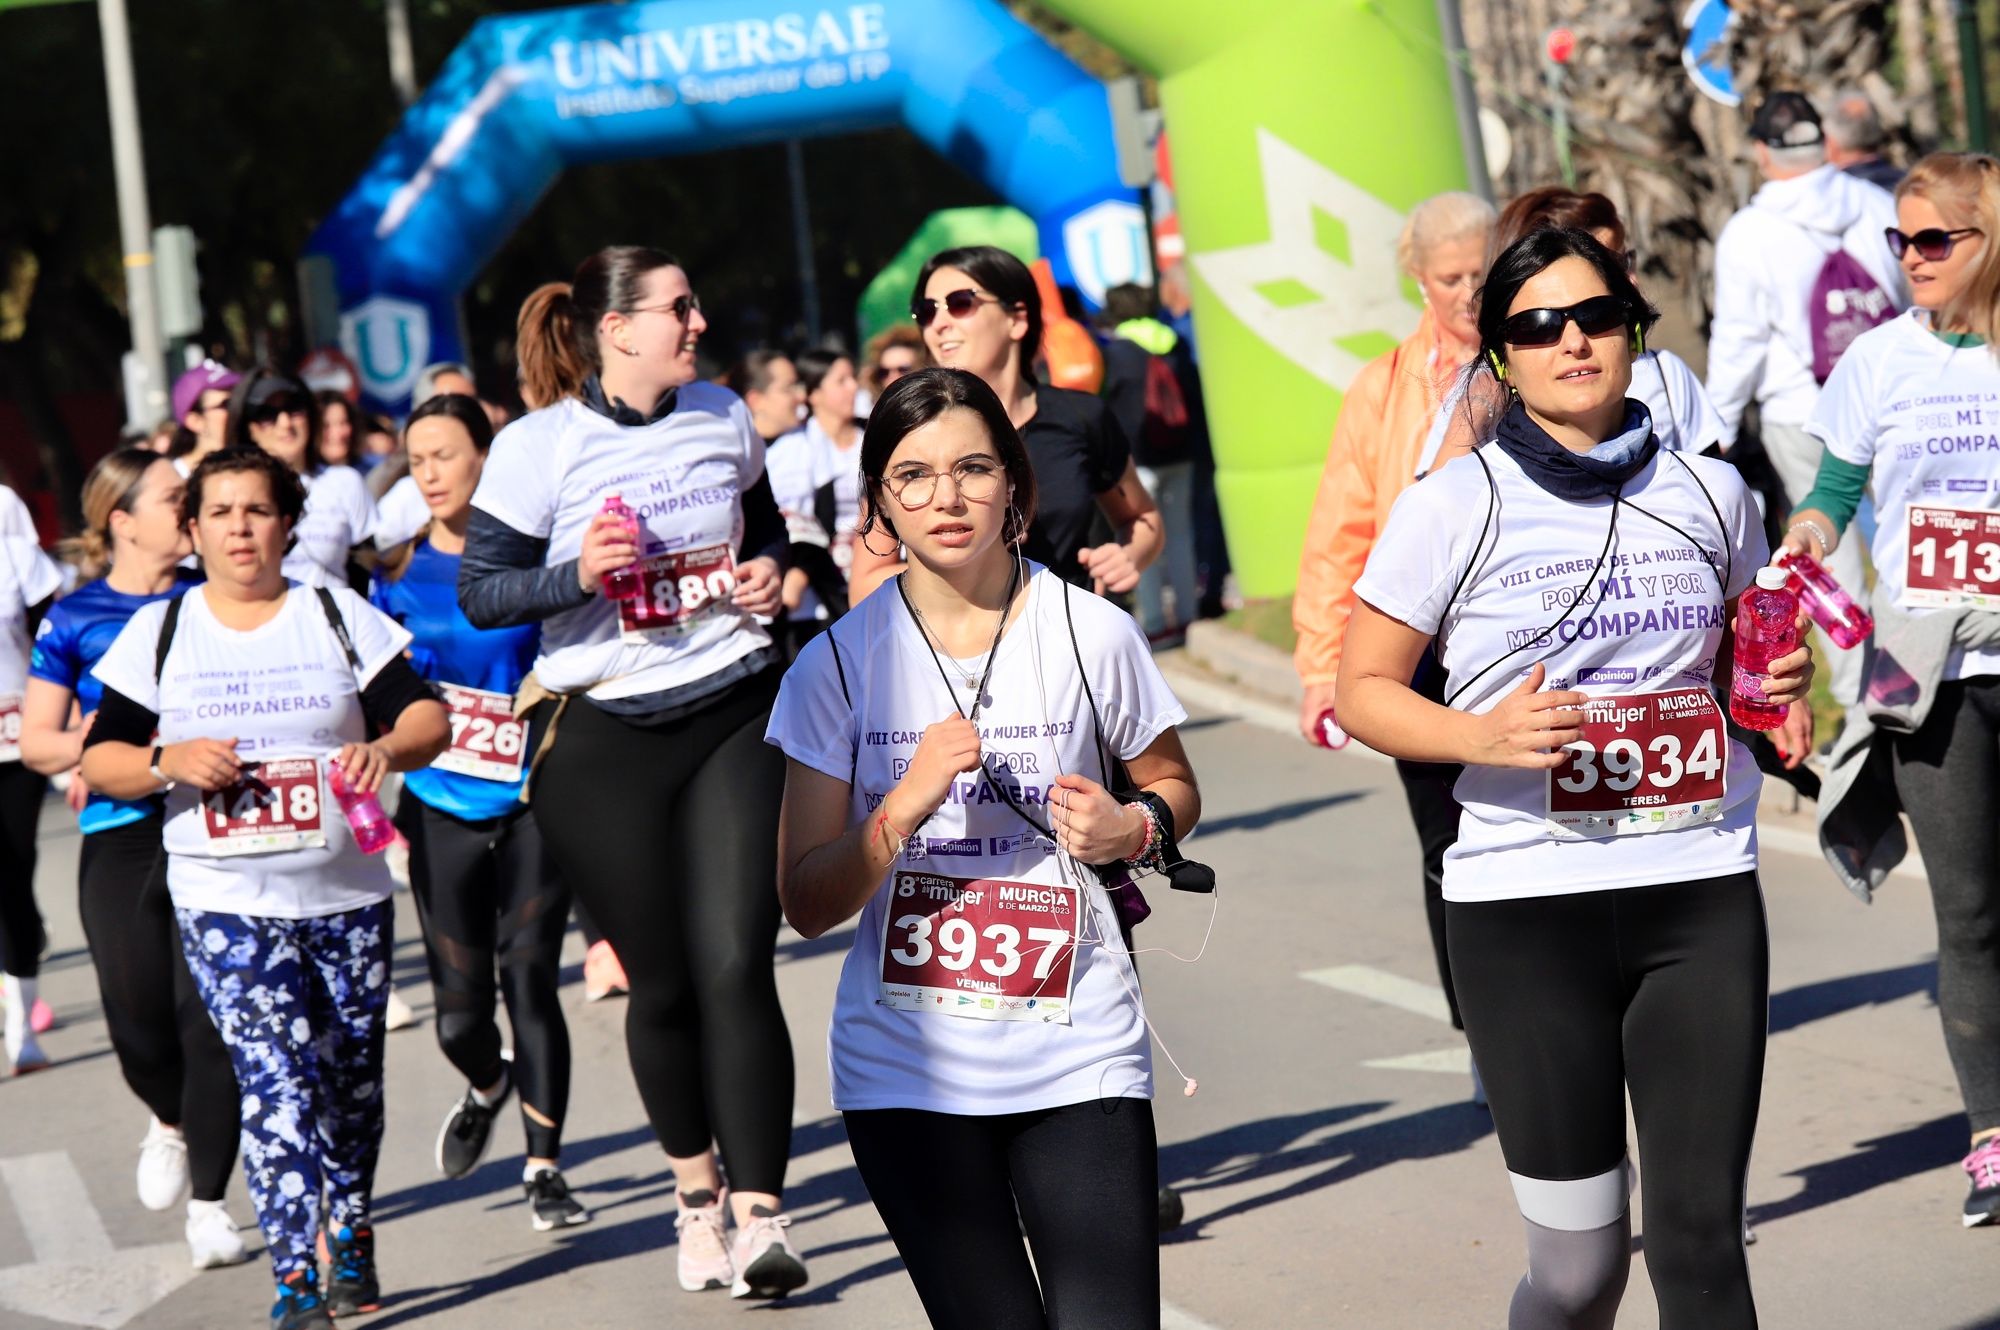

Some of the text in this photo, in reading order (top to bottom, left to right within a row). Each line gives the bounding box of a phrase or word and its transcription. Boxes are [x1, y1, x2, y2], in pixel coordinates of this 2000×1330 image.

[551, 3, 890, 89] UNIVERSAE
[555, 50, 891, 119] Instituto Superior de FP
[354, 315, 411, 386] U
[1957, 404, 1982, 426] MÍ
[1927, 433, 2000, 455] COMPA
[1499, 570, 1531, 588] VIII
[1535, 557, 1606, 579] CARRERA
[1610, 553, 1629, 568] DE
[1633, 552, 1652, 565] LA
[1655, 549, 1696, 562] MUJER
[1911, 537, 2000, 583] 113
[1541, 568, 1707, 611] POR MÍ Y POR
[1506, 599, 1725, 651] MIS COMPAÑERAS
[197, 694, 332, 719] COMPAÑERAS
[1658, 693, 1712, 712] MURCIA
[0, 711, 21, 740] 8
[448, 712, 522, 757] 726
[866, 731, 888, 746] VIII
[993, 725, 1038, 739] MUJER
[1042, 720, 1074, 737] 2023
[1588, 706, 1647, 733] mujer
[1675, 709, 1699, 718] MARZO
[1699, 706, 1715, 715] 2023
[994, 751, 1040, 774] POR
[1557, 728, 1722, 793] 3934
[1622, 793, 1668, 807] TERESA
[920, 876, 955, 888] carrera
[999, 886, 1069, 907] MURCIA
[929, 884, 985, 913] mujer
[998, 901, 1004, 909] 5
[1005, 902, 1017, 910] DE
[1018, 903, 1049, 913] MARZO
[1050, 906, 1071, 915] 2023
[890, 914, 1070, 979] 3937
[955, 977, 998, 992] VENUS
